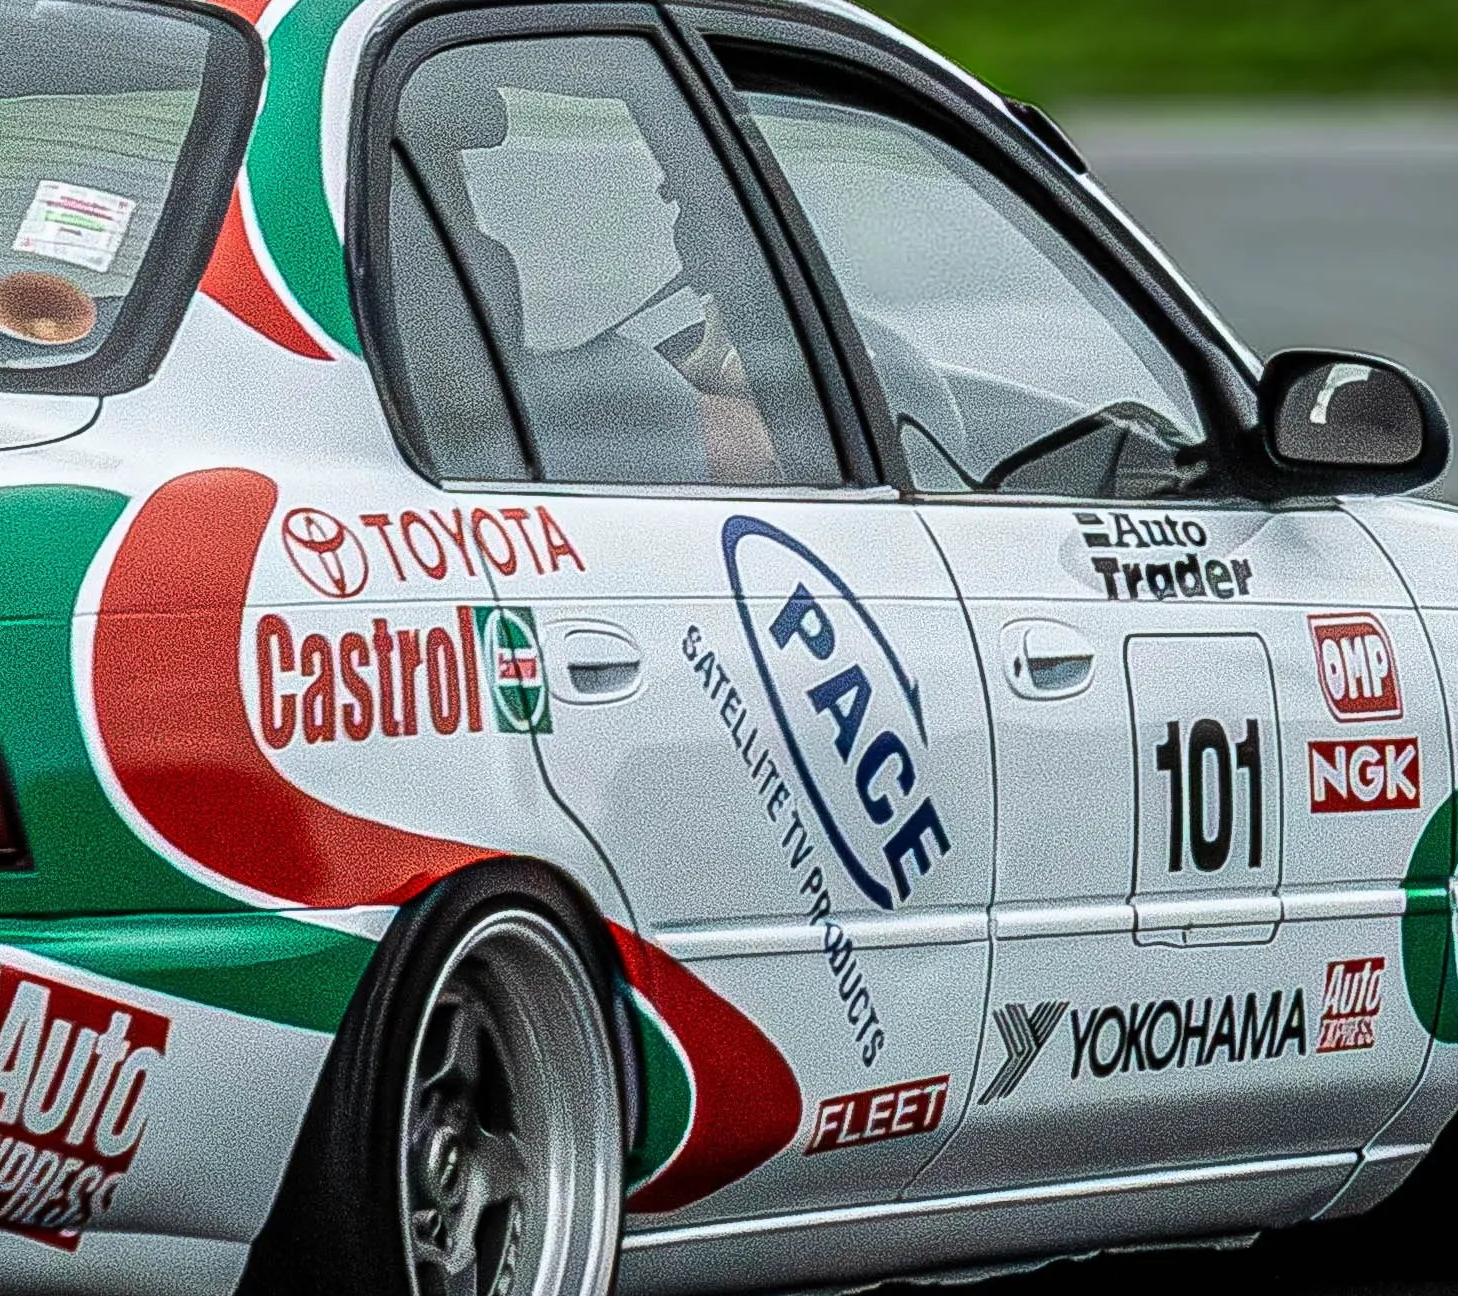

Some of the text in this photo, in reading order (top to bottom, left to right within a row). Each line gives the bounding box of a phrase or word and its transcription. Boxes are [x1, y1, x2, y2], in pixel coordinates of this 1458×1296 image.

[359, 505, 586, 582] TOYOTA
[1108, 512, 1208, 548] Auto
[1090, 552, 1254, 601] Trader
[256, 605, 483, 750] Castrol
[1321, 634, 1389, 701] OMP
[768, 581, 952, 902] PACE
[1311, 744, 1418, 802] NGK
[1155, 718, 1262, 872] 101
[681, 624, 885, 1068] SATELLITE TV PRODUCTS
[1322, 961, 1384, 1016] Auto
[1070, 987, 1307, 1080] YOKOHAMA
[812, 1081, 948, 1149] FLEET
